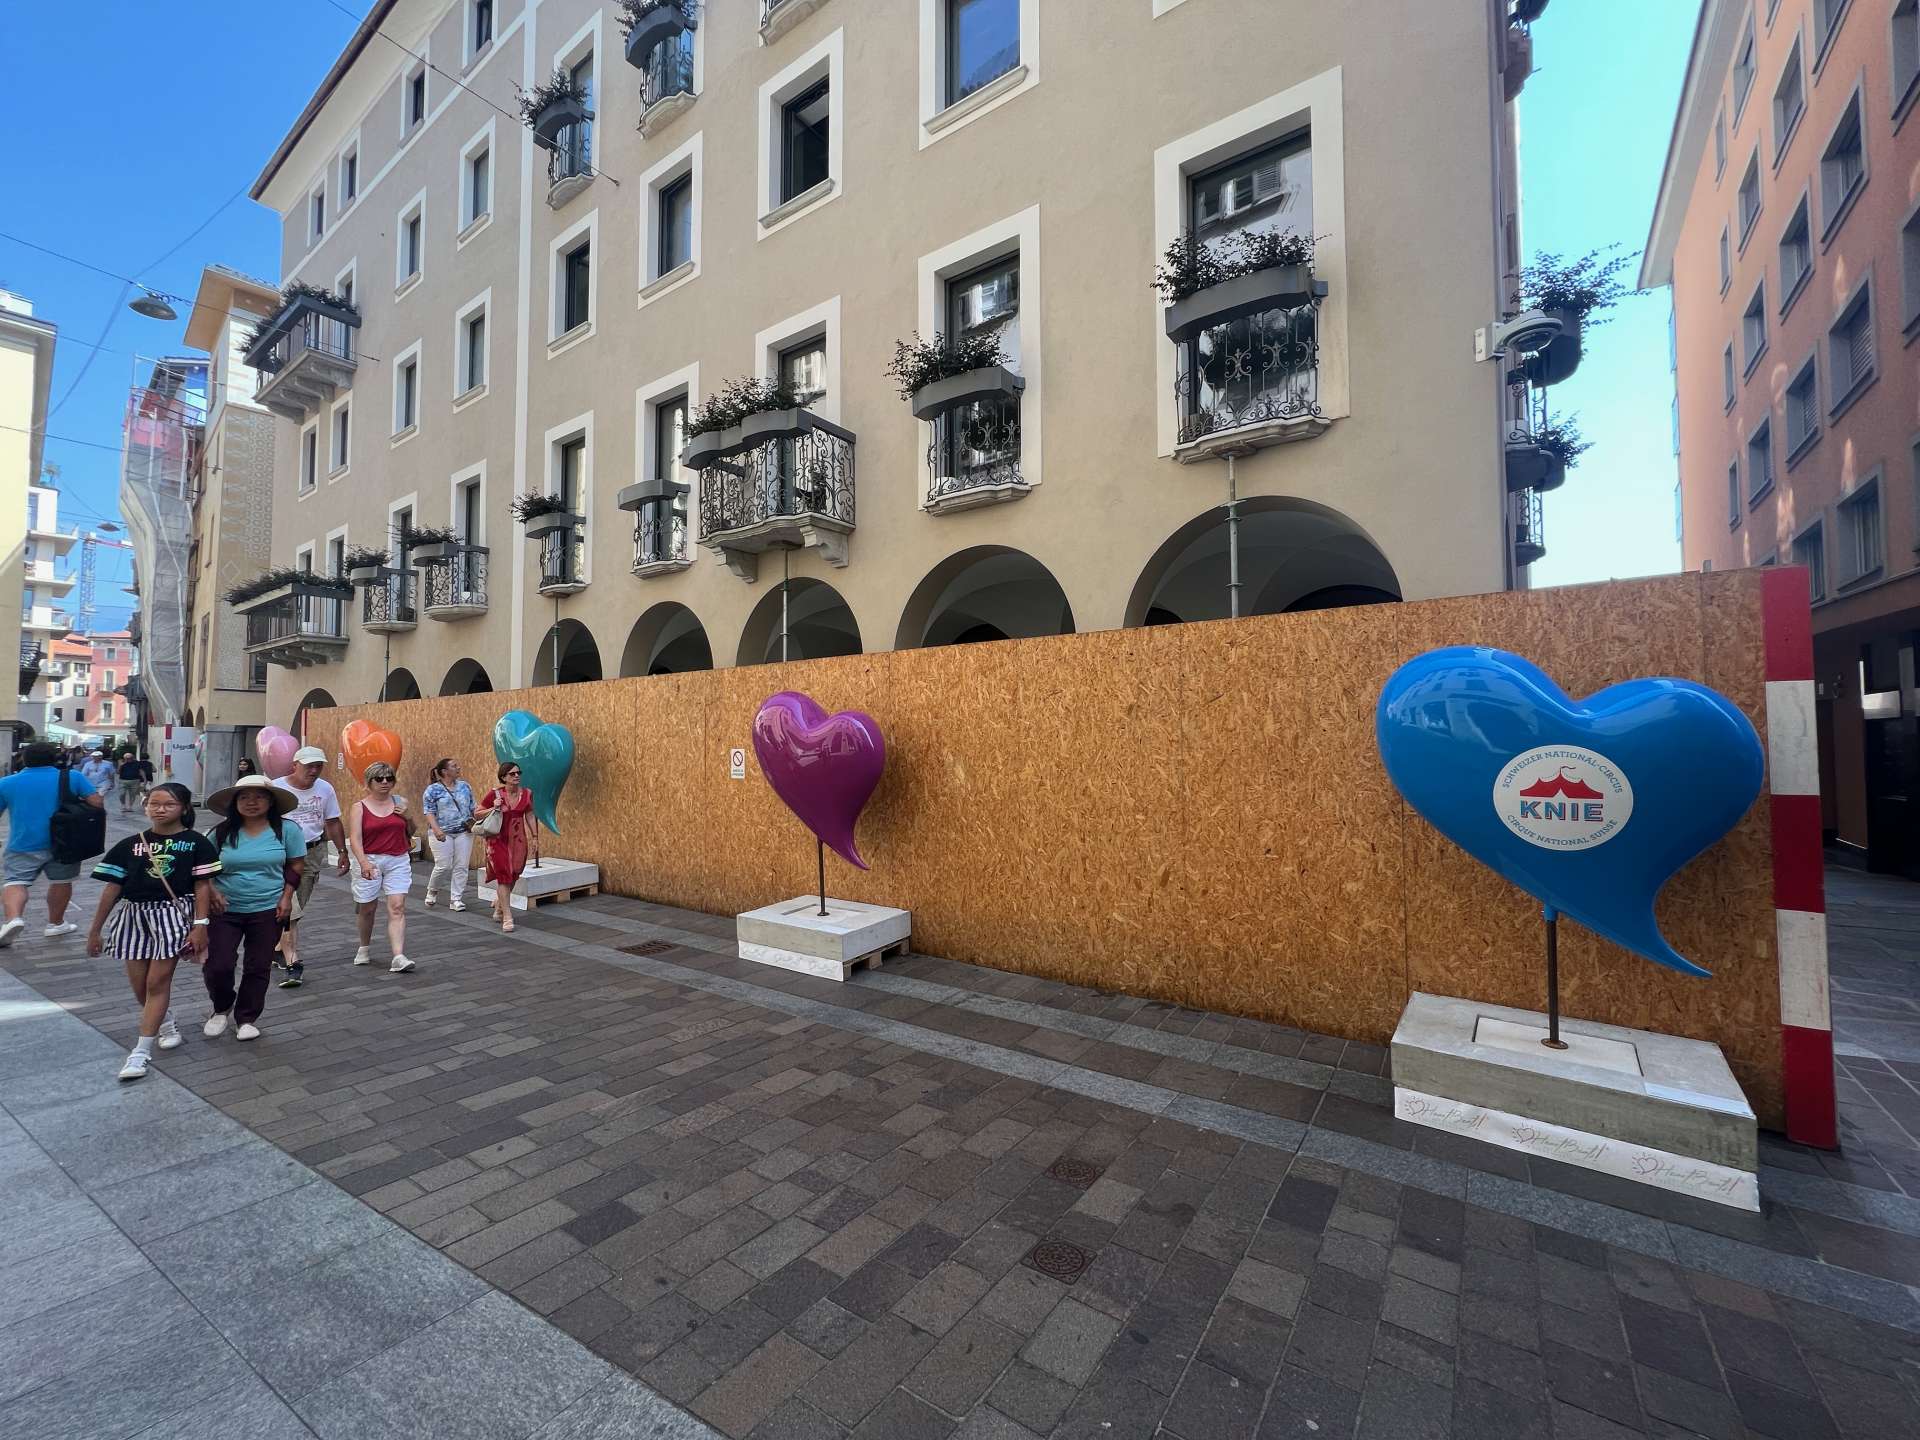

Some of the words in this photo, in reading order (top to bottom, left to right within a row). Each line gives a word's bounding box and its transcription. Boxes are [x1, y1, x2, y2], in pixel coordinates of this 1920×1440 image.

[1502, 753, 1543, 789] SCHWEIZER
[1520, 800, 1604, 822] KNIE
[1507, 814, 1536, 838] CIRQUE
[1536, 834, 1589, 846] NATIONAL
[1590, 818, 1618, 841] SUISSE
[163, 838, 196, 855] Potter
